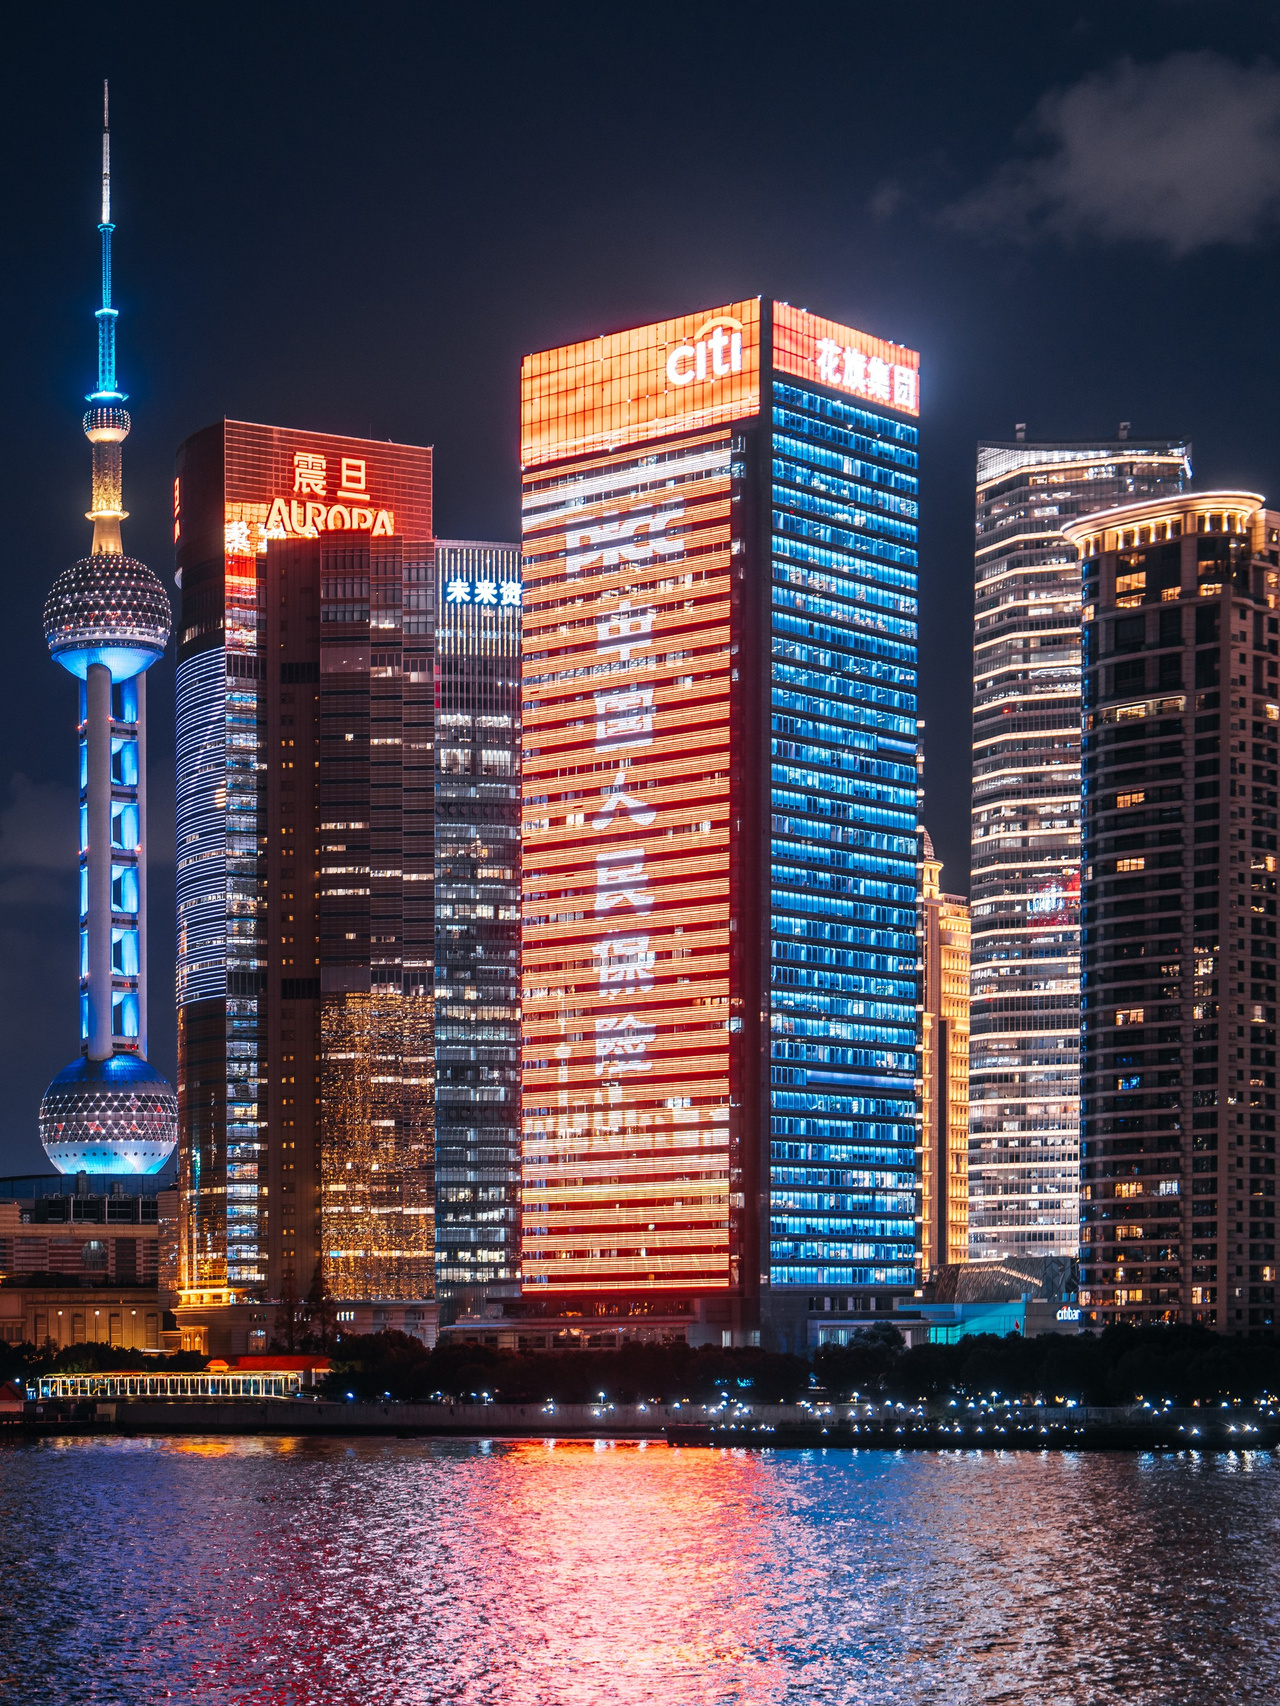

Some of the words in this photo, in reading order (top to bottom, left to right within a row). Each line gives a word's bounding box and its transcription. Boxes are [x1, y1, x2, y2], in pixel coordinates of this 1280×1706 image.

[667, 326, 743, 385] citi
[816, 337, 916, 410] 花旗集团
[293, 452, 370, 501] 震旦
[566, 495, 685, 582] PICC
[446, 578, 522, 606] 未来资
[592, 600, 657, 1076] 中国人民保险
